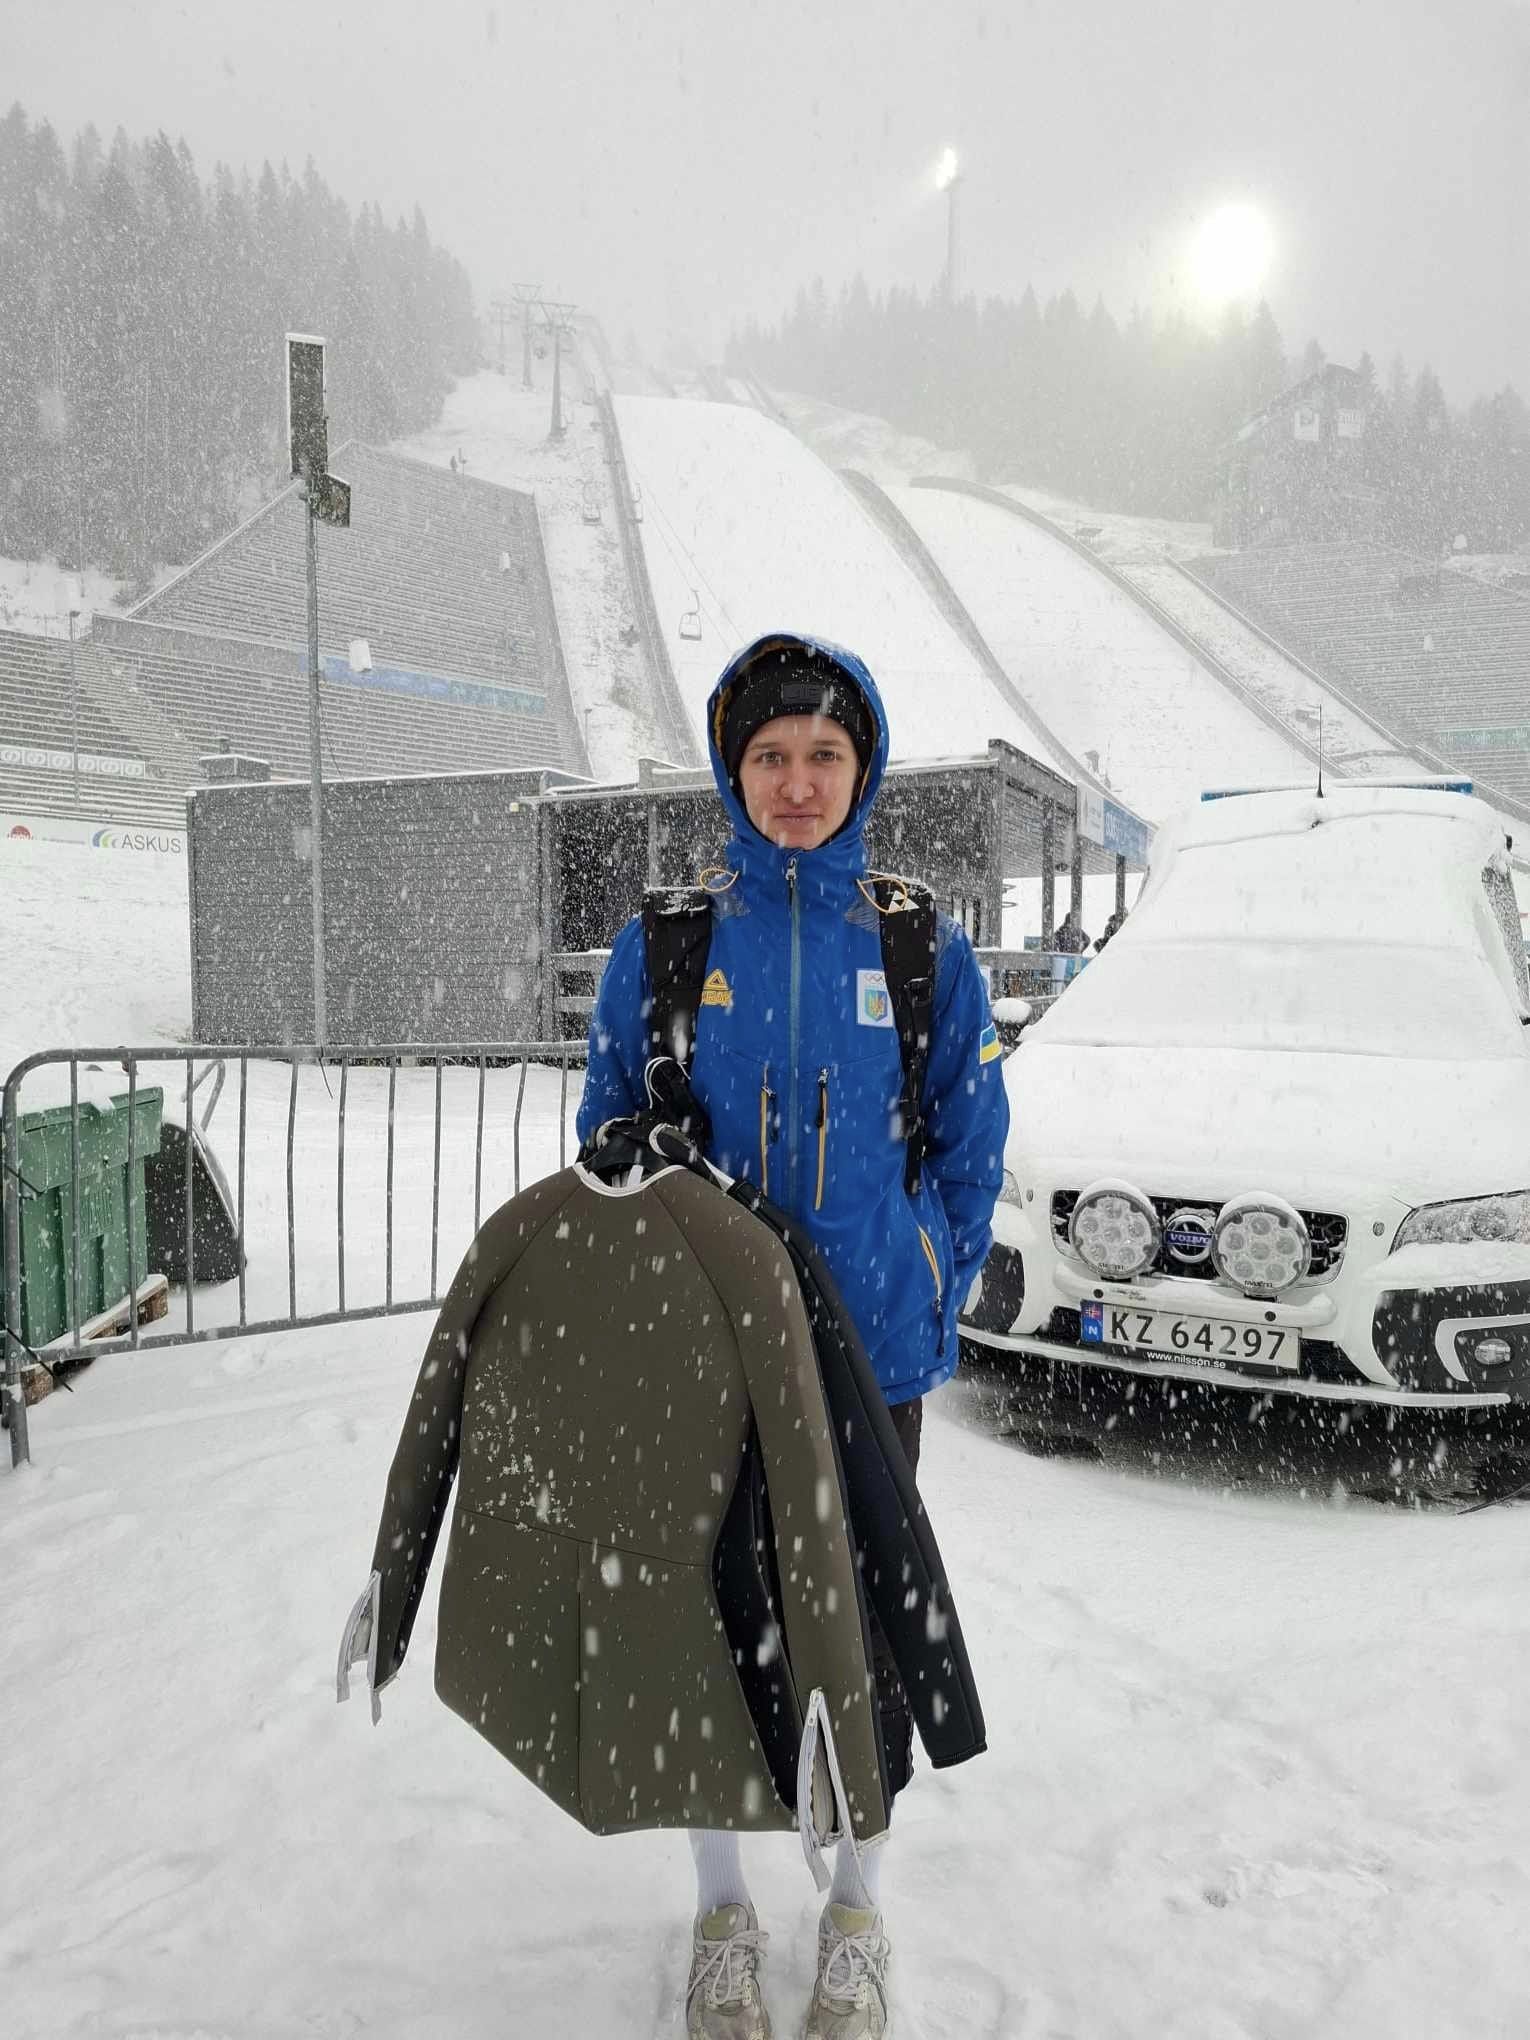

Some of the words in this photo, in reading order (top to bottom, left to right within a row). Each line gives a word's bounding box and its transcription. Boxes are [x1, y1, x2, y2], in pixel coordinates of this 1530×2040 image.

[121, 834, 182, 854] ASKUS
[1087, 1325, 1099, 1336] N
[1110, 1311, 1153, 1345] KZ
[1170, 1320, 1286, 1361] 64297
[1146, 1350, 1227, 1370] www.nilsson.se
